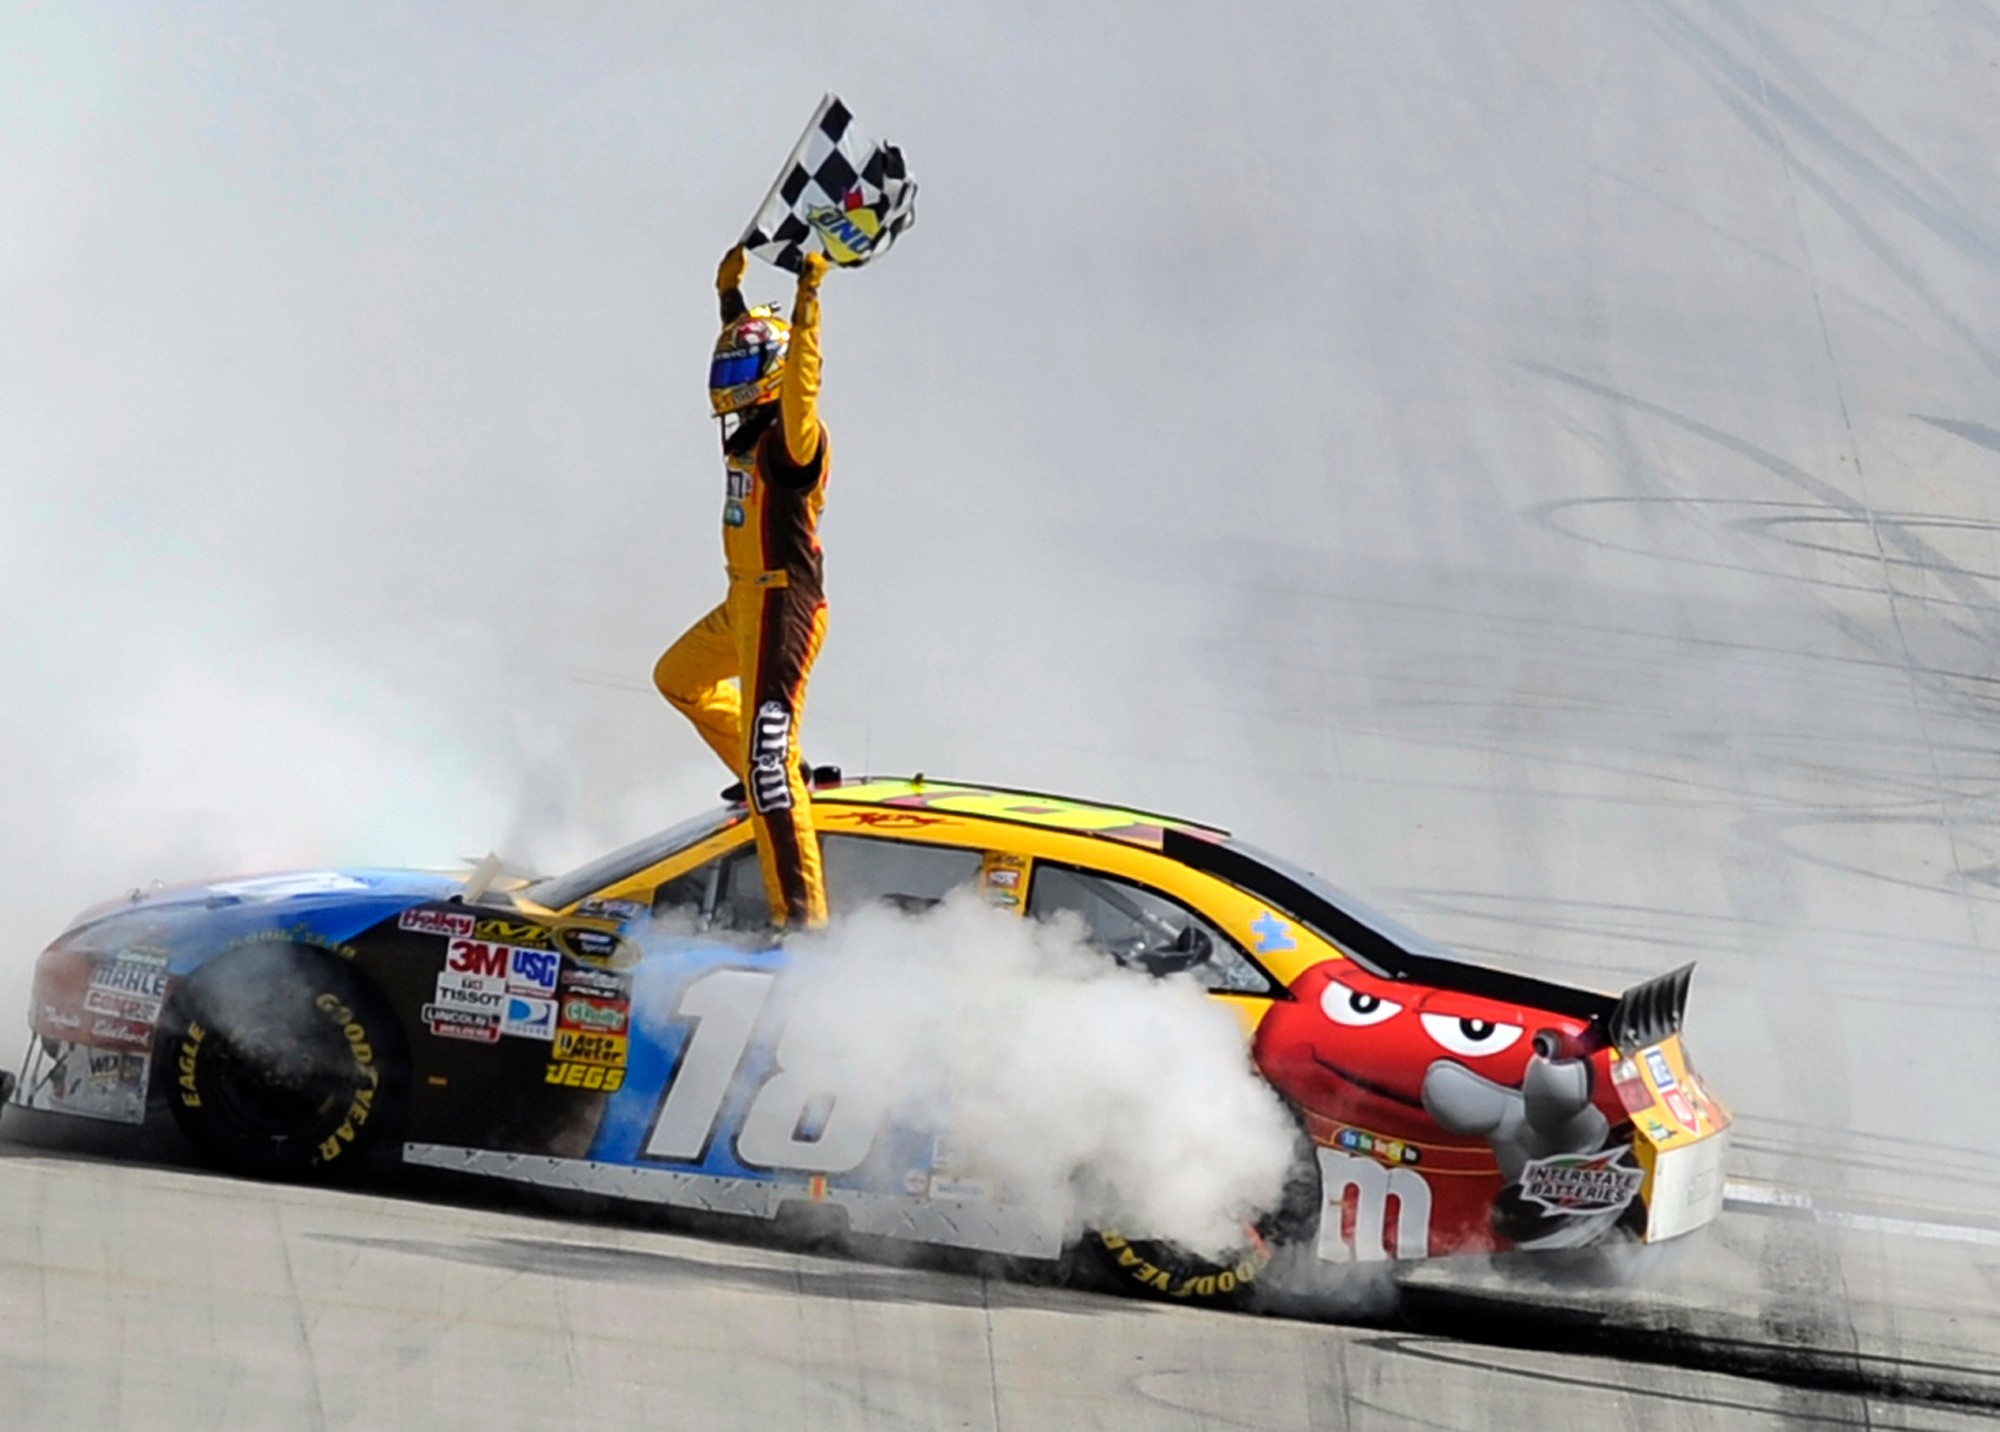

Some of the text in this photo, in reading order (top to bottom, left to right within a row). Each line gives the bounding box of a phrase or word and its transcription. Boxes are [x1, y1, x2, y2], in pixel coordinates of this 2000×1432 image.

[449, 941, 509, 978] 3M
[513, 950, 557, 987] USG
[96, 965, 165, 996] MAHLE
[440, 986, 503, 1007] TISSOT
[427, 1009, 490, 1027] LINCOLN
[572, 1047, 622, 1061] Meter
[576, 1034, 614, 1050] Auto
[179, 1021, 206, 1107] EAGLE
[316, 993, 379, 1162] GOODYEAR
[545, 1063, 626, 1091] JEGS
[641, 967, 905, 1173] 18
[1527, 1166, 1636, 1188] INTERSTATE
[1317, 1147, 1432, 1261] m
[1530, 1183, 1627, 1203] BATTERIES
[1101, 1229, 1268, 1296] OODYEAR
